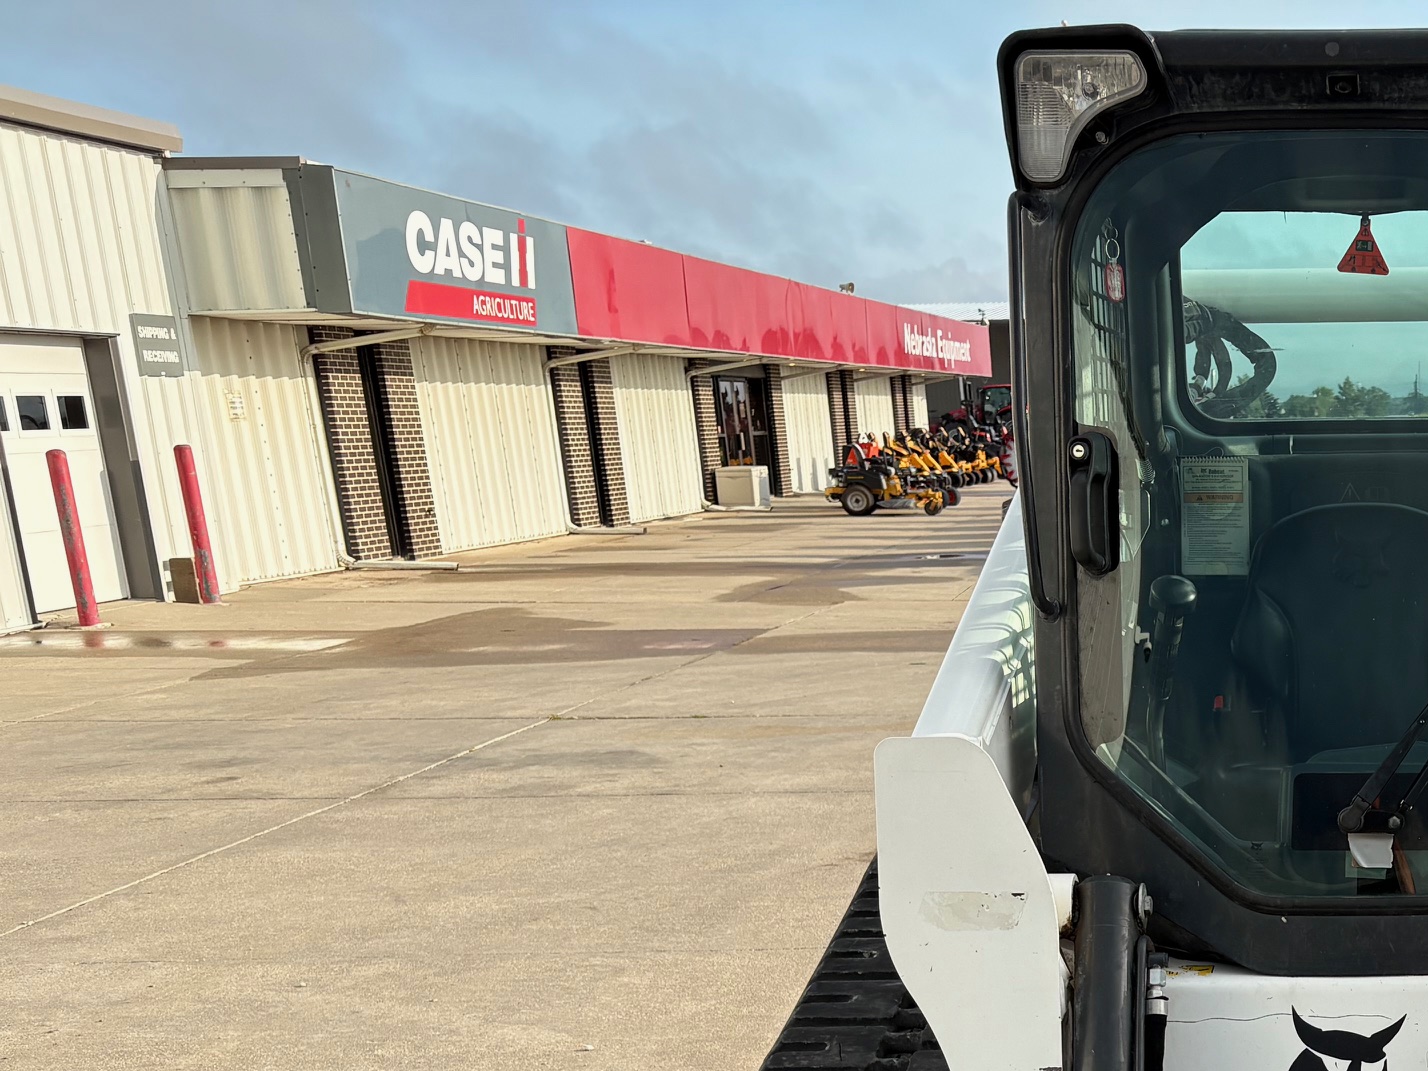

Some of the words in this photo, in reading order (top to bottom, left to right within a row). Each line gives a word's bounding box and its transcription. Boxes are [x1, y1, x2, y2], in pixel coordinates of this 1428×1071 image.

[405, 210, 506, 285] CASE
[473, 295, 535, 321] AGRICULTURE
[137, 325, 169, 339] SHIPPING
[142, 349, 179, 363] RECEIVING
[904, 322, 937, 358] Nebraska
[937, 329, 971, 369] Equipment
